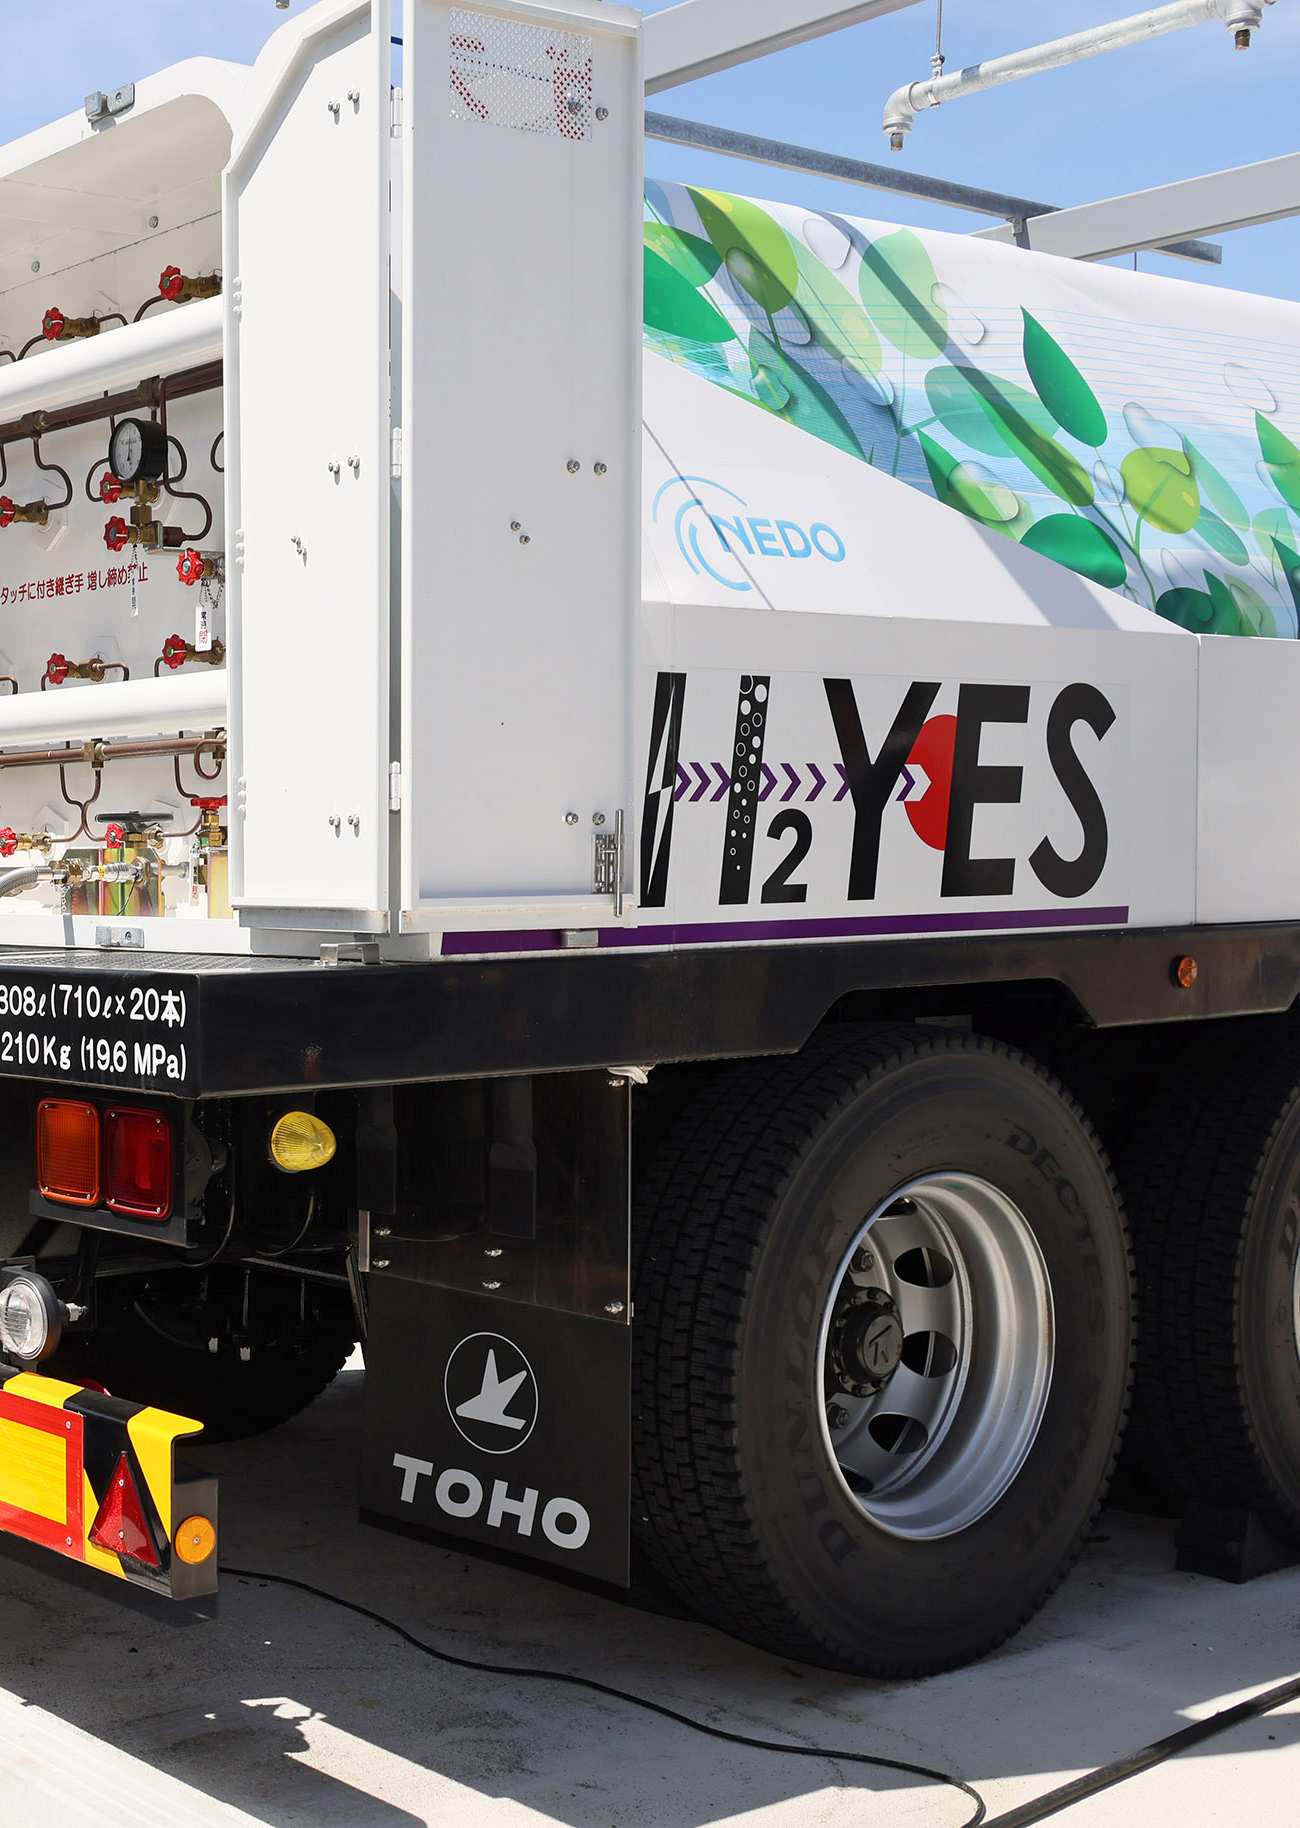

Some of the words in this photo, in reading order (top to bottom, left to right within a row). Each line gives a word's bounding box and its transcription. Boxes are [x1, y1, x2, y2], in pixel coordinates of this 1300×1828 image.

[707, 513, 847, 563] NEDO
[1, 1031, 71, 1070] 210Kg
[81, 1038, 128, 1073] (19.6
[134, 1043, 187, 1081] MPa)
[393, 1453, 591, 1550] TOHO
